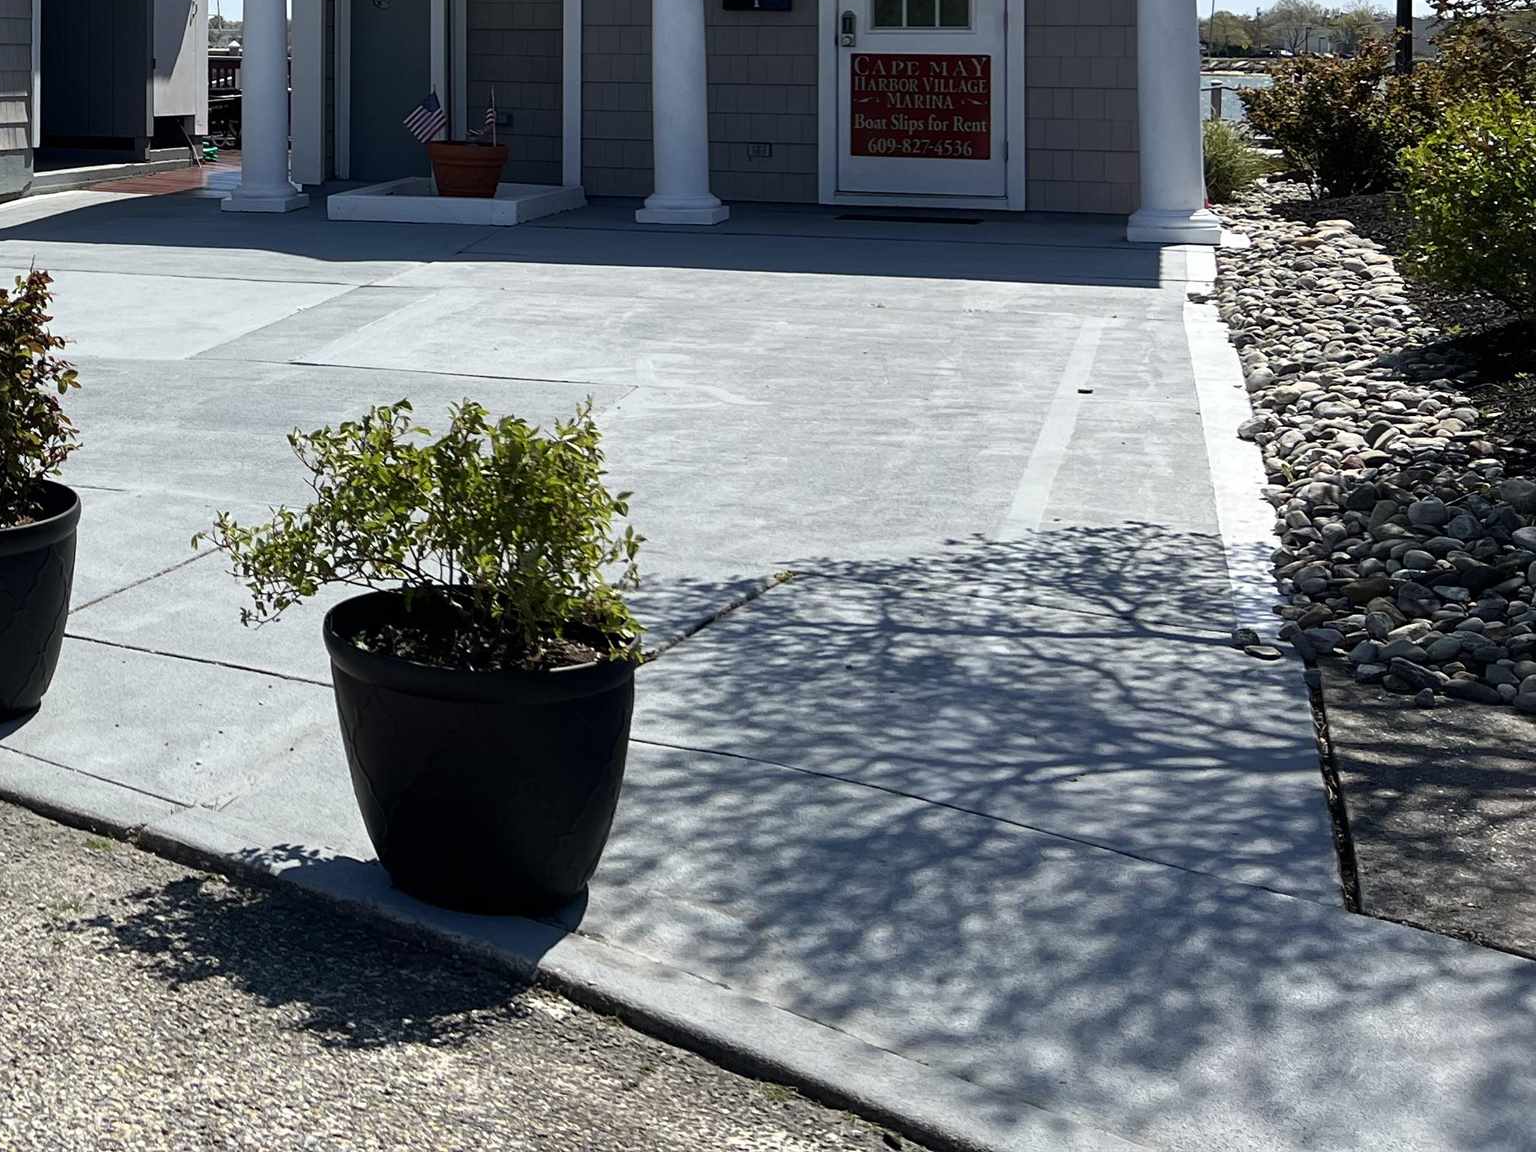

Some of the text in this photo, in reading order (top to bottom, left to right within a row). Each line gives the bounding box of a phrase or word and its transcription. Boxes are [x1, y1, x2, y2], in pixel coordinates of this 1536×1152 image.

[854, 55, 987, 77] CAPE MAY
[854, 76, 988, 94] HARBOR VILLAGE
[887, 92, 954, 110] MARINA
[854, 113, 987, 135] Boat Slips for Rent
[867, 137, 973, 157] 609-827-4536
